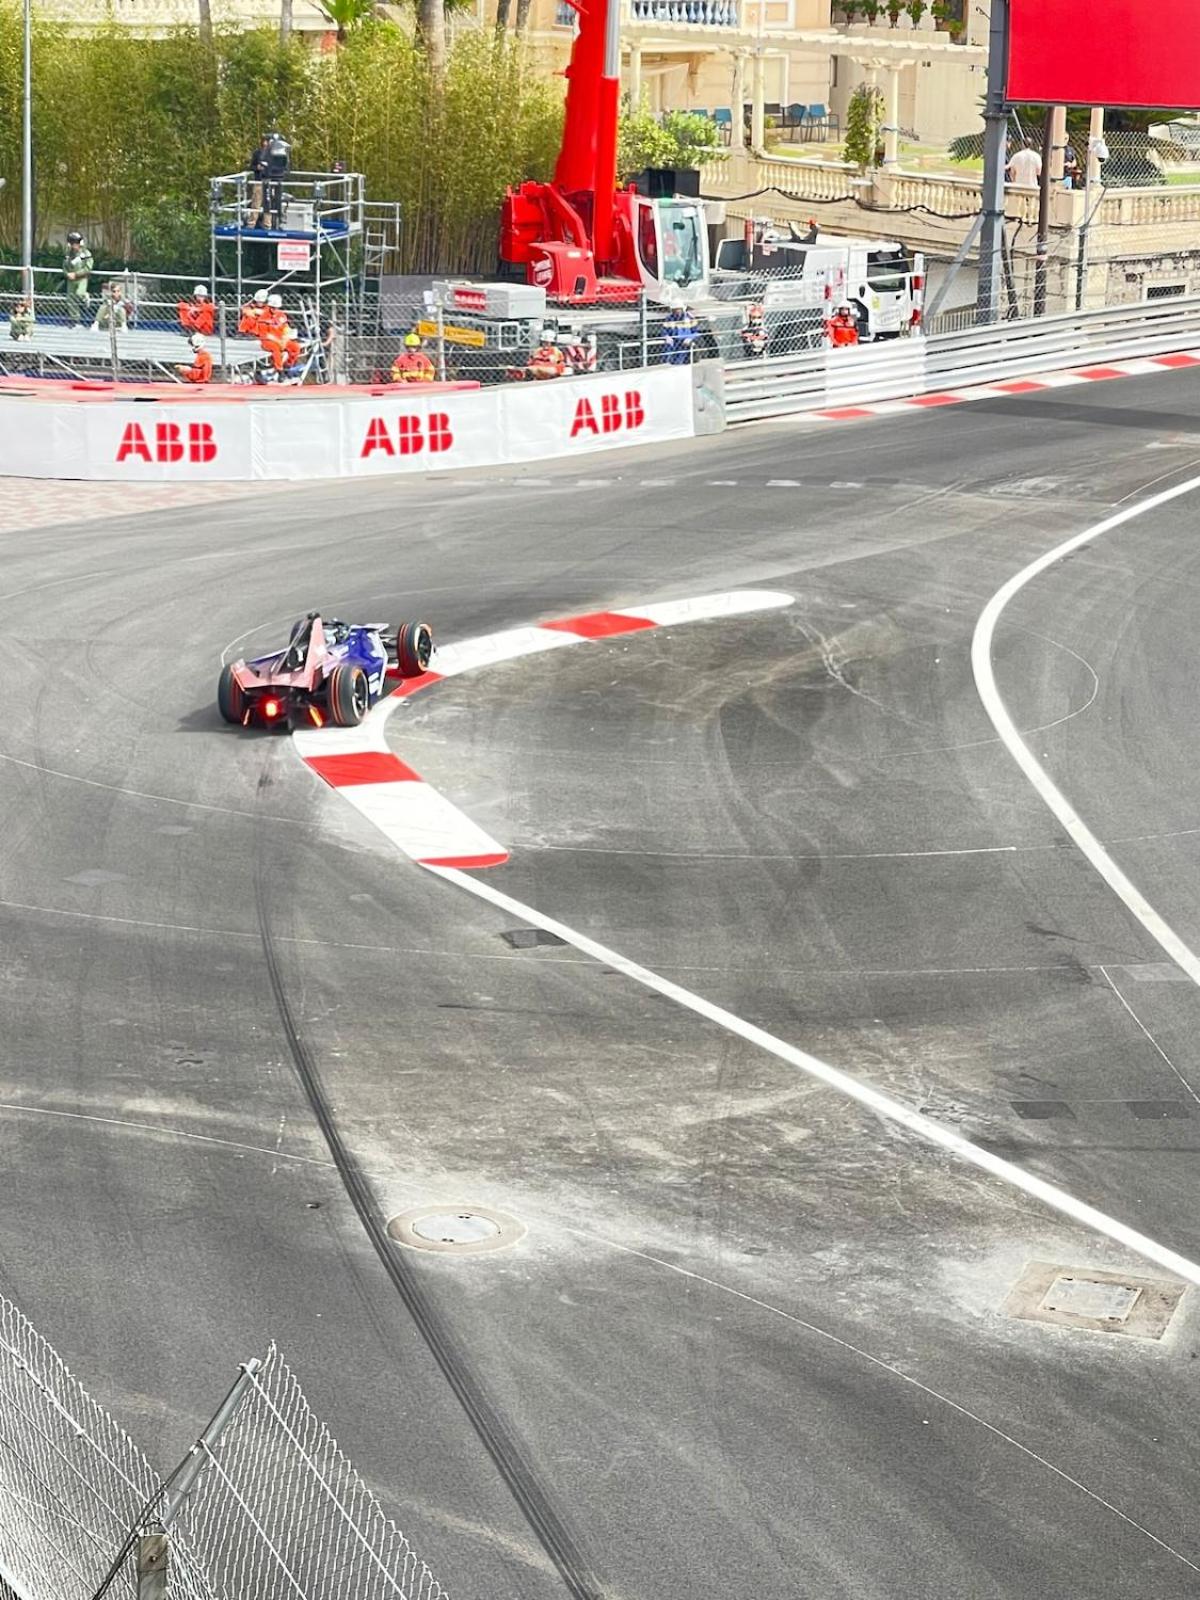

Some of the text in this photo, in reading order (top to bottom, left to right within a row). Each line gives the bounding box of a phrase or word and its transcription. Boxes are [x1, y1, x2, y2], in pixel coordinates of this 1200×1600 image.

[361, 413, 453, 457] ABB
[570, 392, 645, 437] ABB
[116, 423, 217, 463] ABB
